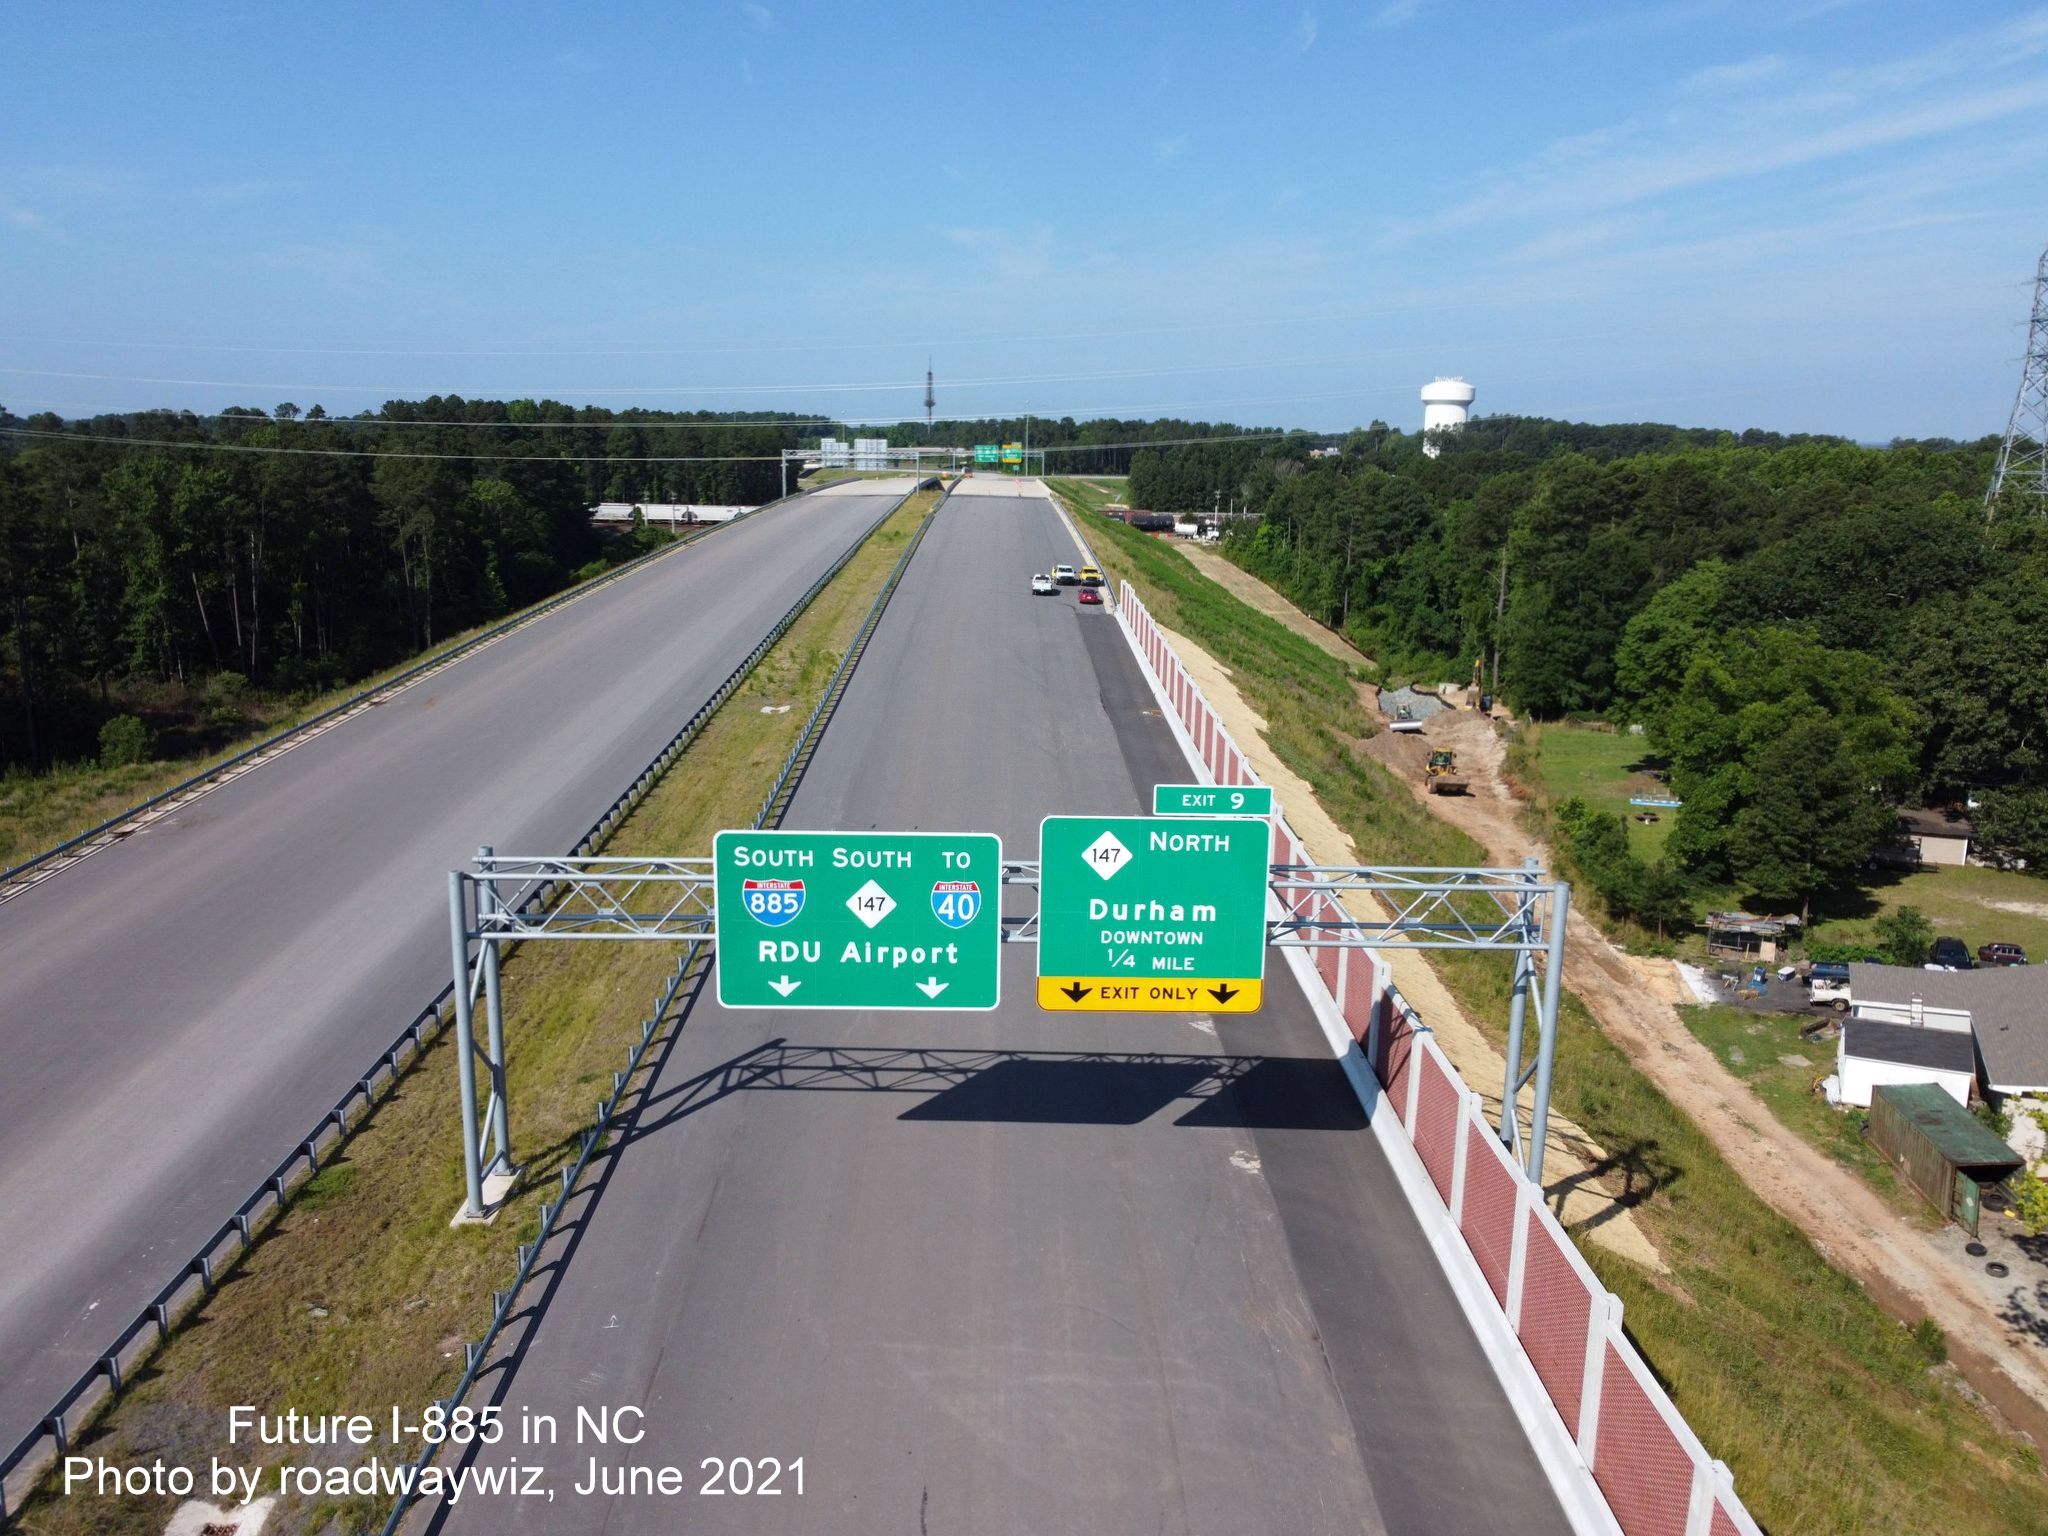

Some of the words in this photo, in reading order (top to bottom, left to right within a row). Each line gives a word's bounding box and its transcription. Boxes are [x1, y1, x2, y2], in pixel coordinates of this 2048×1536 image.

[1183, 795, 1216, 806] EXIT
[1231, 793, 1244, 809] 9
[1150, 832, 1229, 851] NORTH
[734, 846, 813, 866] SOUTH
[833, 848, 911, 867] SOUTH
[942, 852, 970, 868] TO
[1093, 849, 1120, 862] 147
[756, 881, 793, 890] INTERSTATE
[938, 883, 975, 892] INTERSTATE
[750, 893, 799, 915] 885
[858, 897, 885, 911] 147
[937, 896, 975, 921] 40
[1090, 899, 1216, 921] Durham
[1101, 931, 1203, 944] DOWNTOWN
[759, 941, 820, 962] RDU
[840, 942, 957, 967] Airport
[1108, 949, 1135, 967] 1/4
[1153, 957, 1194, 970] MILE
[1101, 987, 1139, 999] EXIT
[1150, 988, 1197, 999] ONLY
